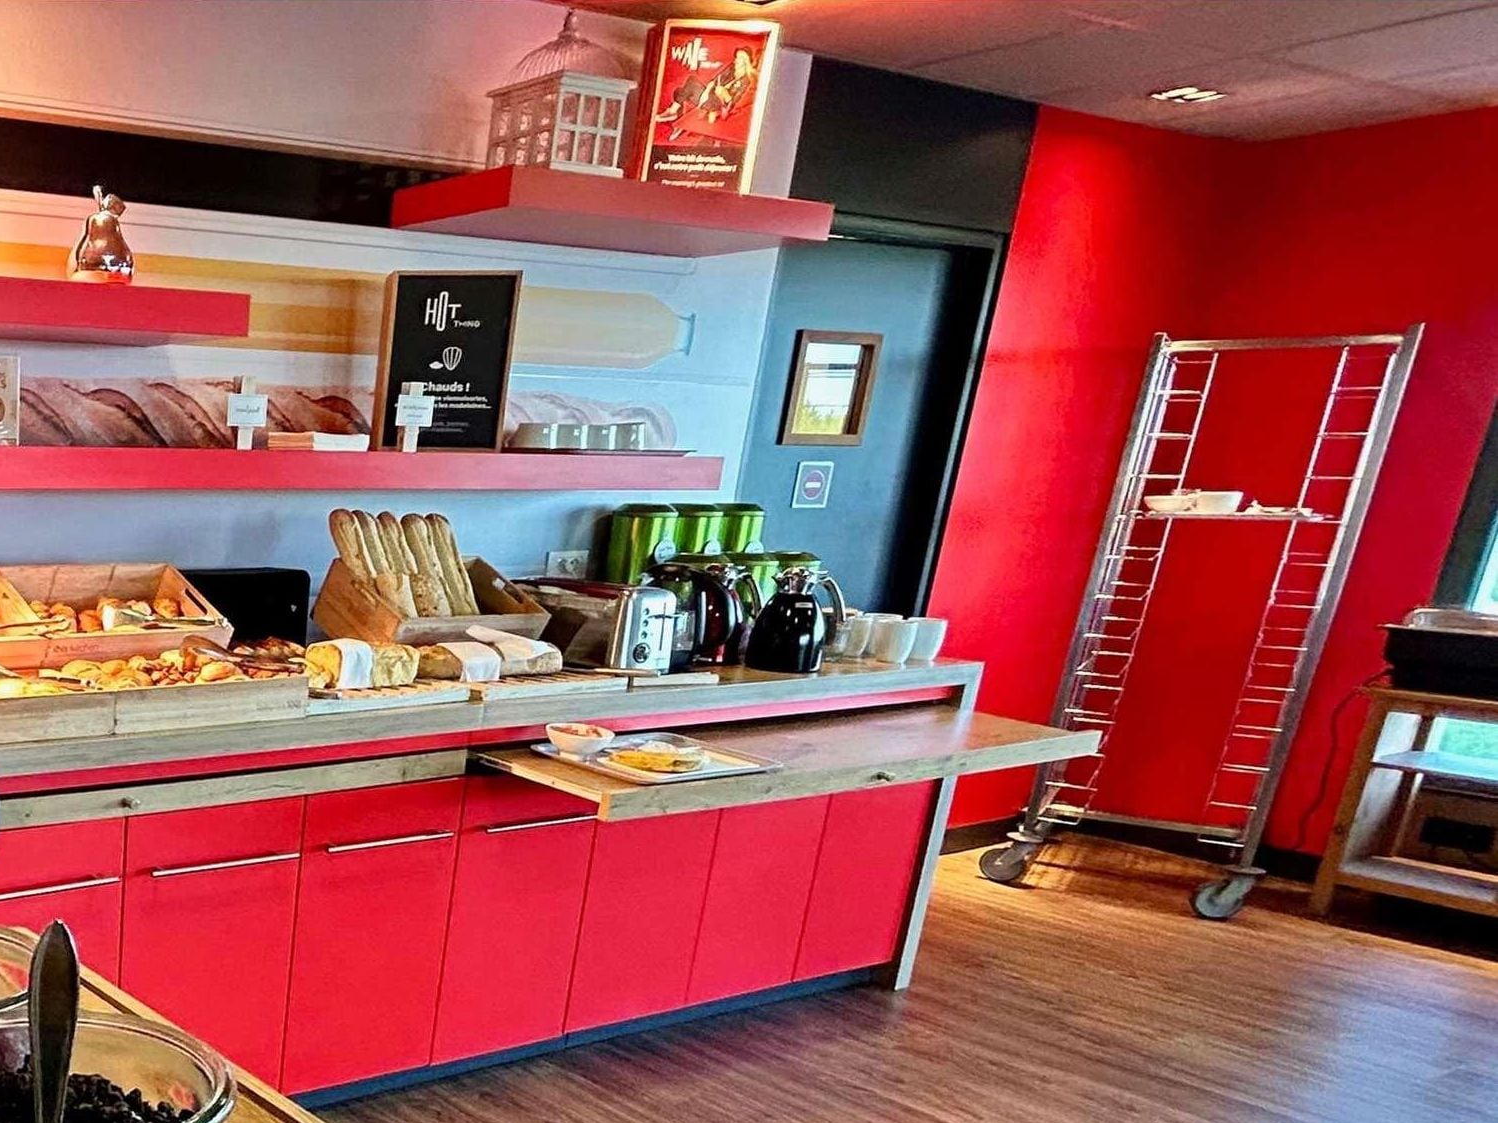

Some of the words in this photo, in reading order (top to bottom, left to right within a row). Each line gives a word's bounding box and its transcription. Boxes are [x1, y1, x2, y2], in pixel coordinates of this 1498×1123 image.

[424, 290, 462, 331] HOT
[453, 319, 481, 328] THING
[422, 380, 464, 392] Chauds
